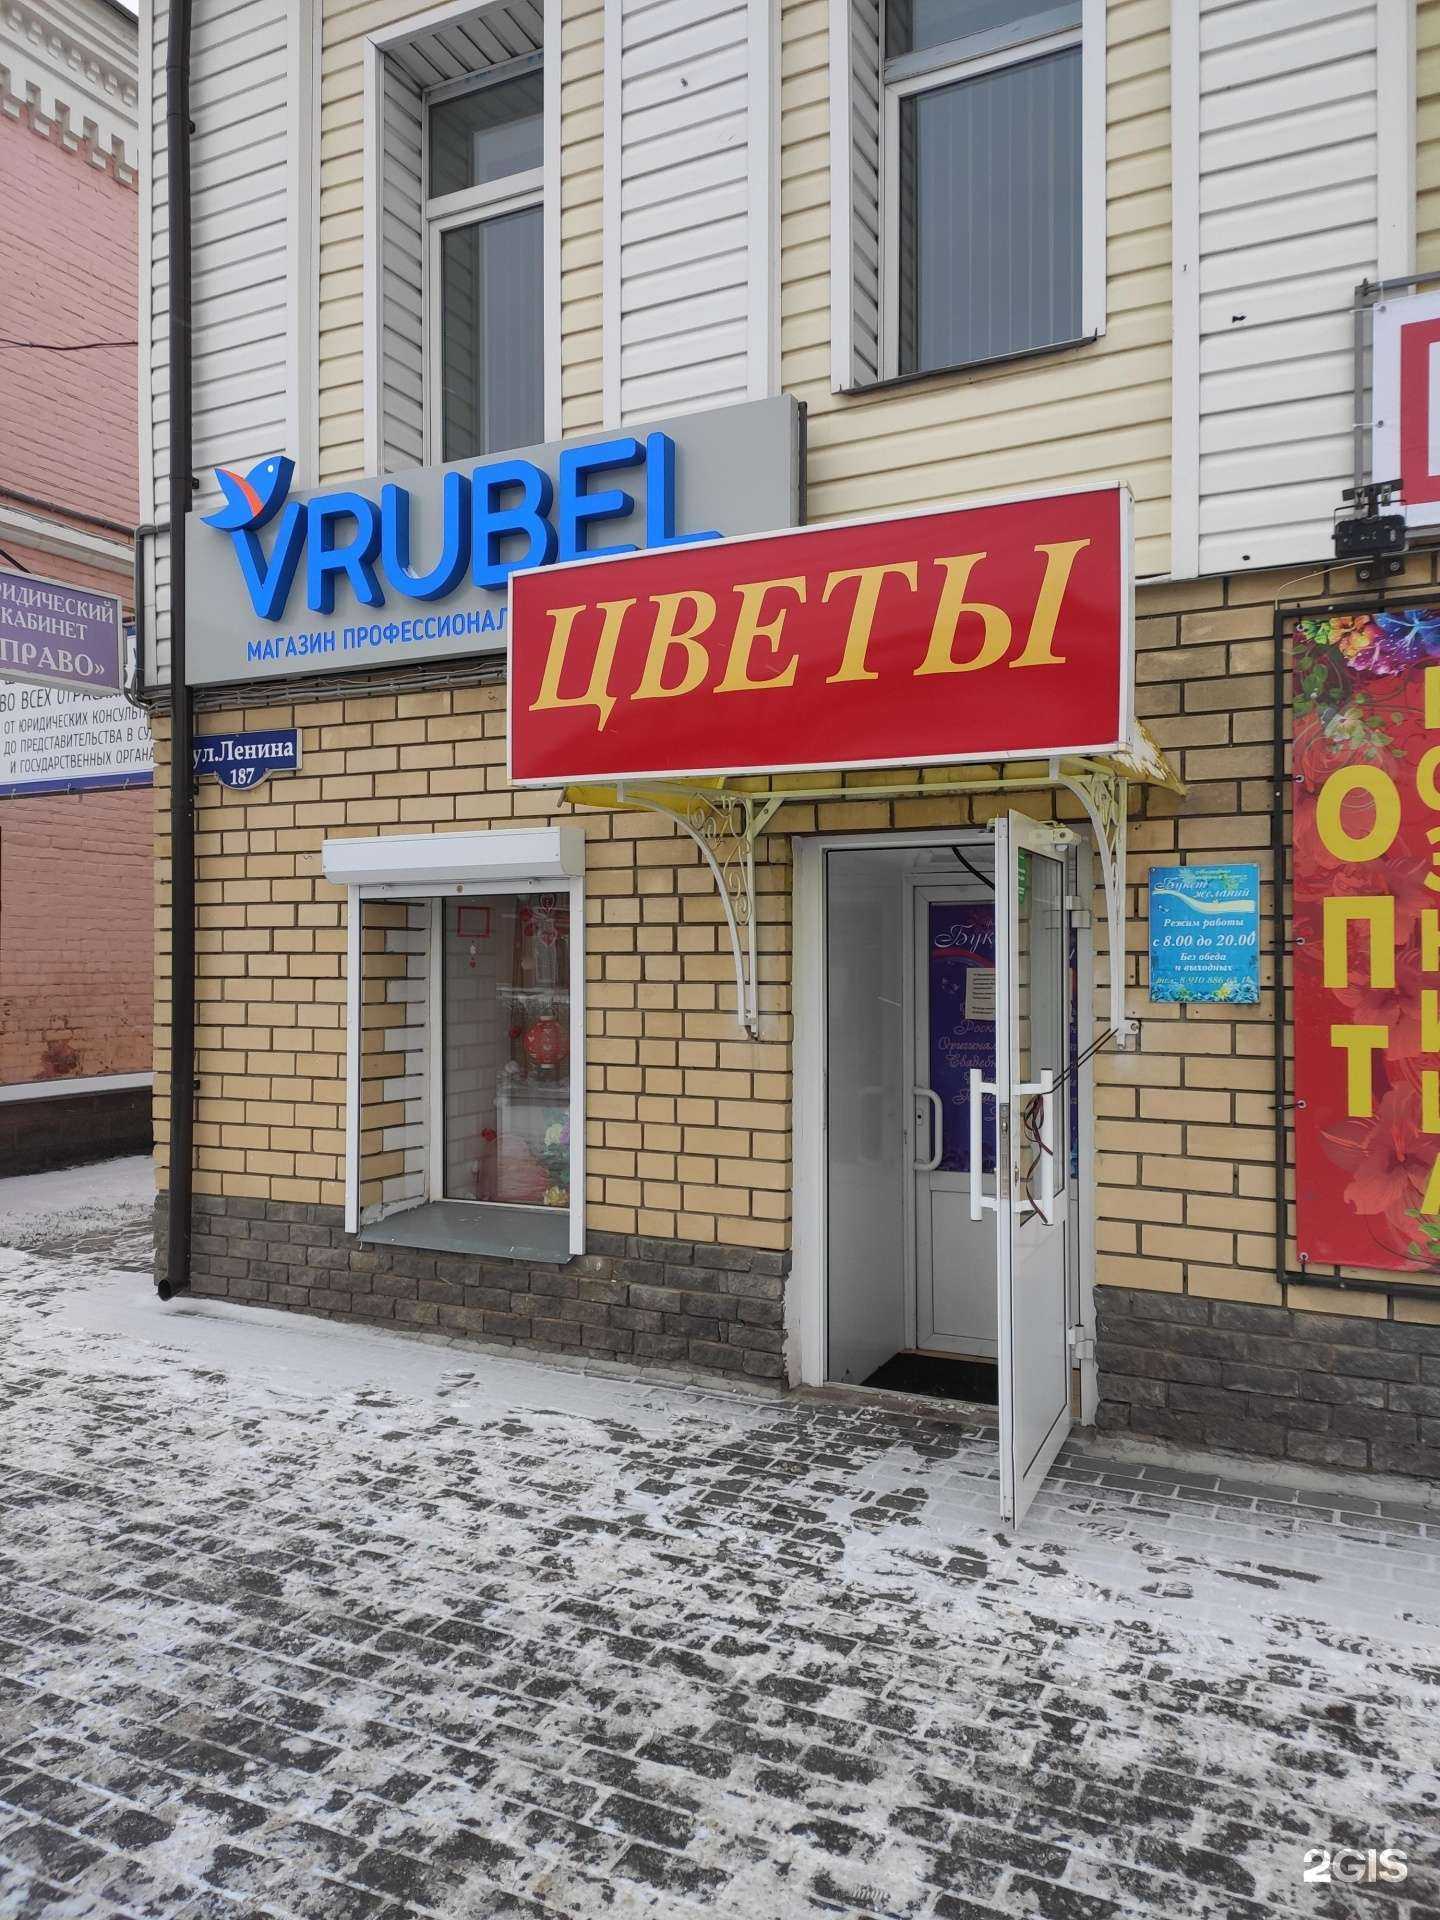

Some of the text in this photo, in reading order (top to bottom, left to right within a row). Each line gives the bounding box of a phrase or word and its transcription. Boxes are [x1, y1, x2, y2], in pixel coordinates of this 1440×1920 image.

[231, 431, 725, 622] VRUBEL
[0, 582, 114, 624] ИДИЧЕСКИЙ
[0, 606, 88, 641] КАБИНЕТ
[528, 538, 1091, 732] ЦВЕТЫ
[247, 630, 336, 662] МАГАЗИН
[21, 688, 51, 710] ВСЕХ
[4, 720, 14, 734] ОТ
[18, 711, 88, 734] ЮРИДИЧЕСКИХ
[3, 740, 16, 756] ДО
[20, 729, 122, 753] ПРЕДСТАВИТЕЛЬСТВА
[127, 727, 133, 742] В
[10, 762, 17, 774] И
[19, 752, 112, 774] ГОСУДАРСТВЕННЫХ
[230, 768, 254, 785] 187
[1163, 918, 1244, 930] Режим работы
[1162, 935, 1193, 947] 8.00
[1196, 935, 1213, 947] до
[1216, 932, 1256, 947] 20.00
[1316, 764, 1402, 1118] ОПТ
[1180, 952, 1227, 961] Без обеда
